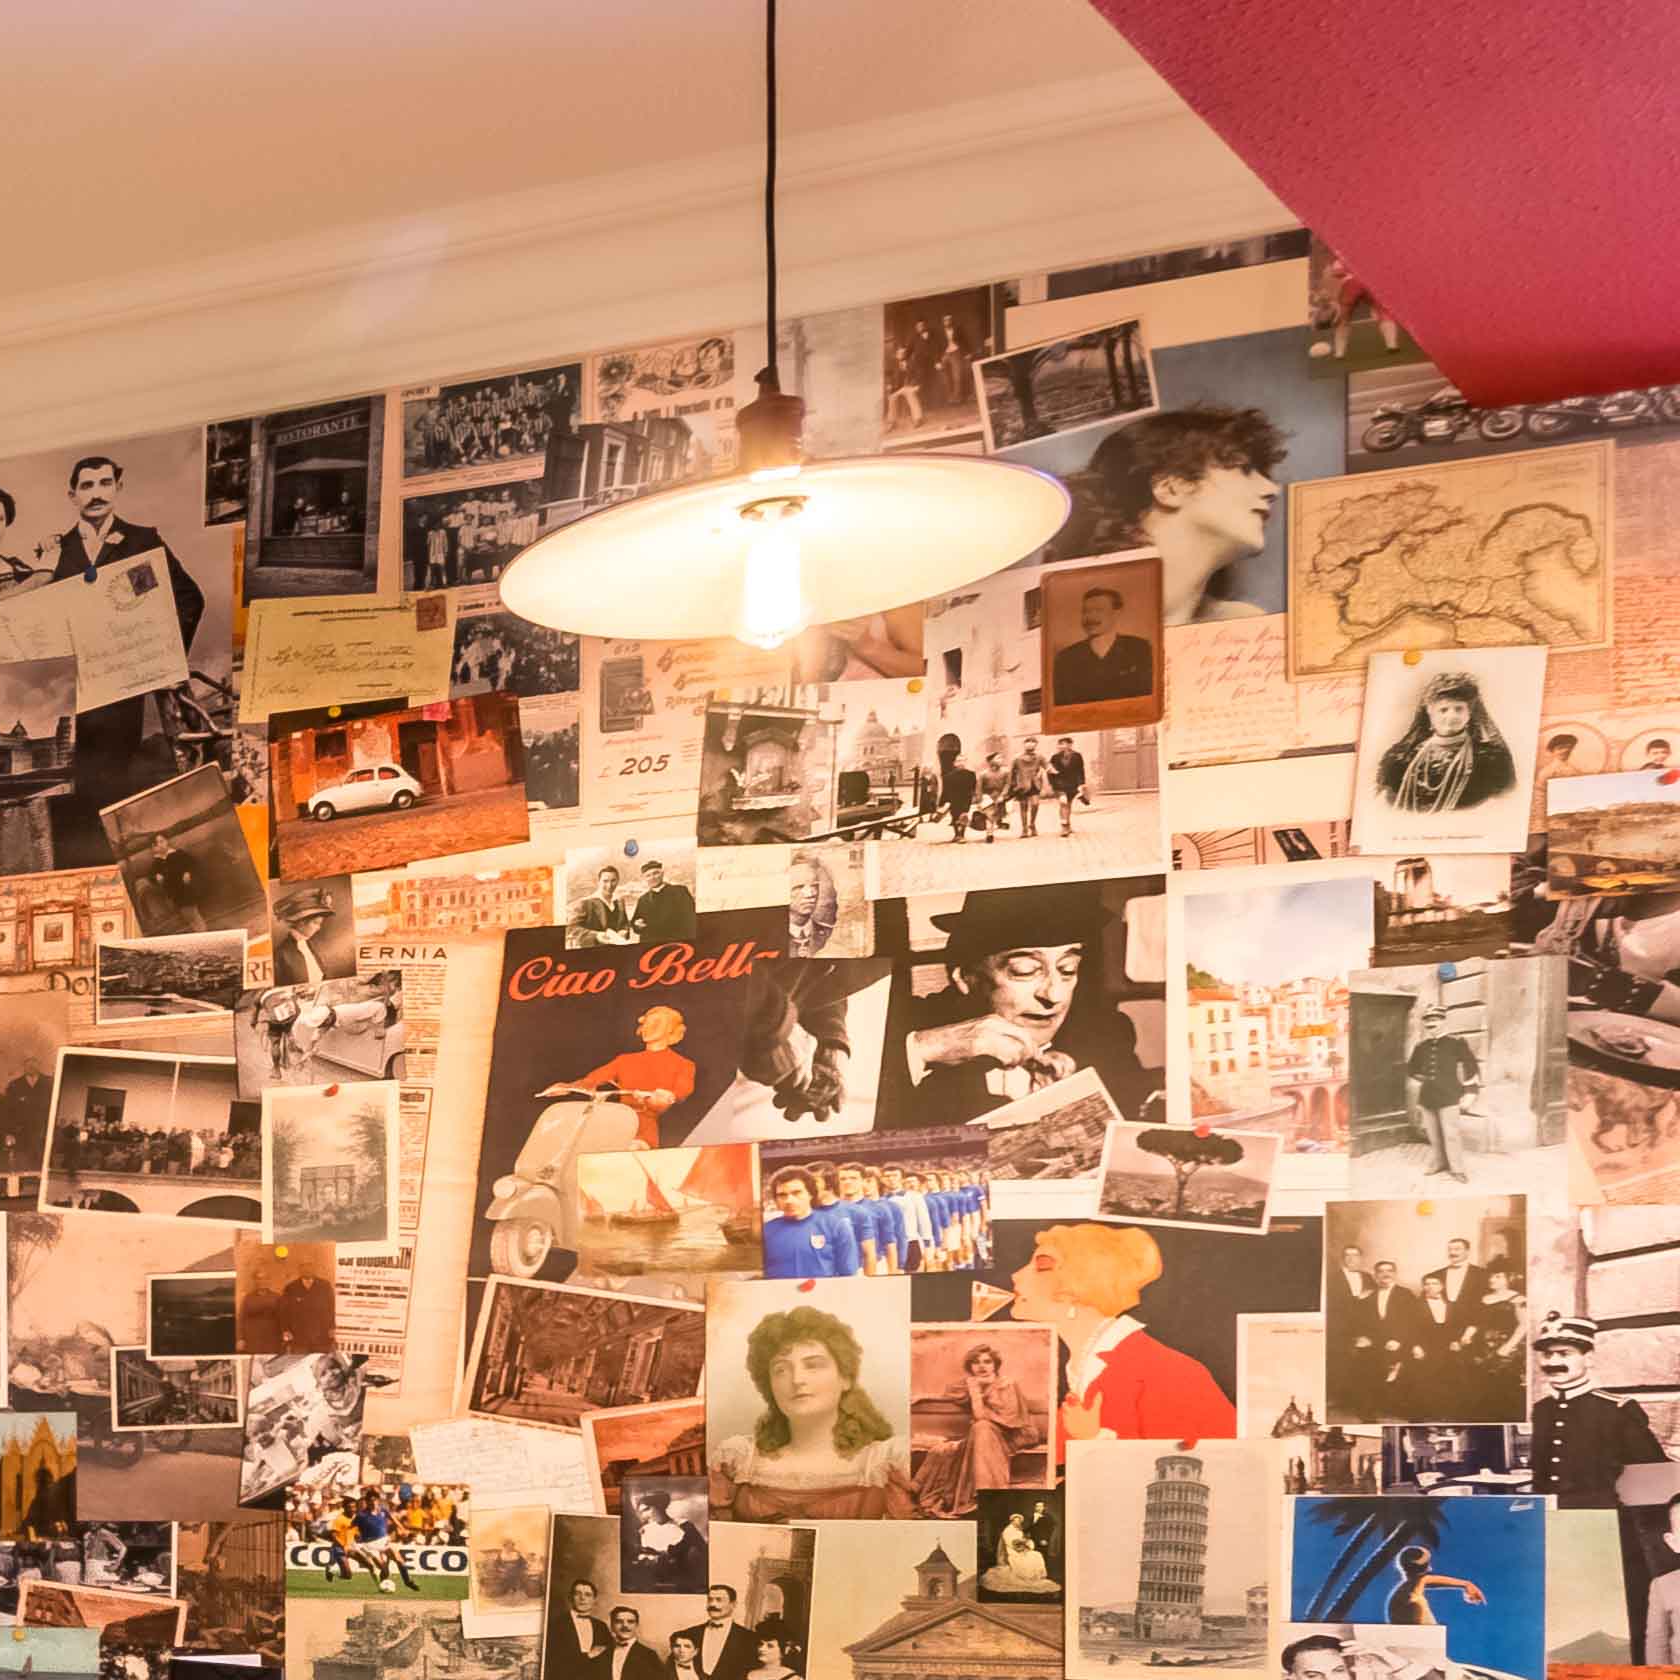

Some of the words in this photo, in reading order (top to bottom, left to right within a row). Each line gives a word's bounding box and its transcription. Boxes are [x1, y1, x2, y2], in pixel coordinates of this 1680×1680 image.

[619, 753, 672, 776] 205
[508, 956, 616, 1001] Ciao
[628, 941, 780, 989] Bell
